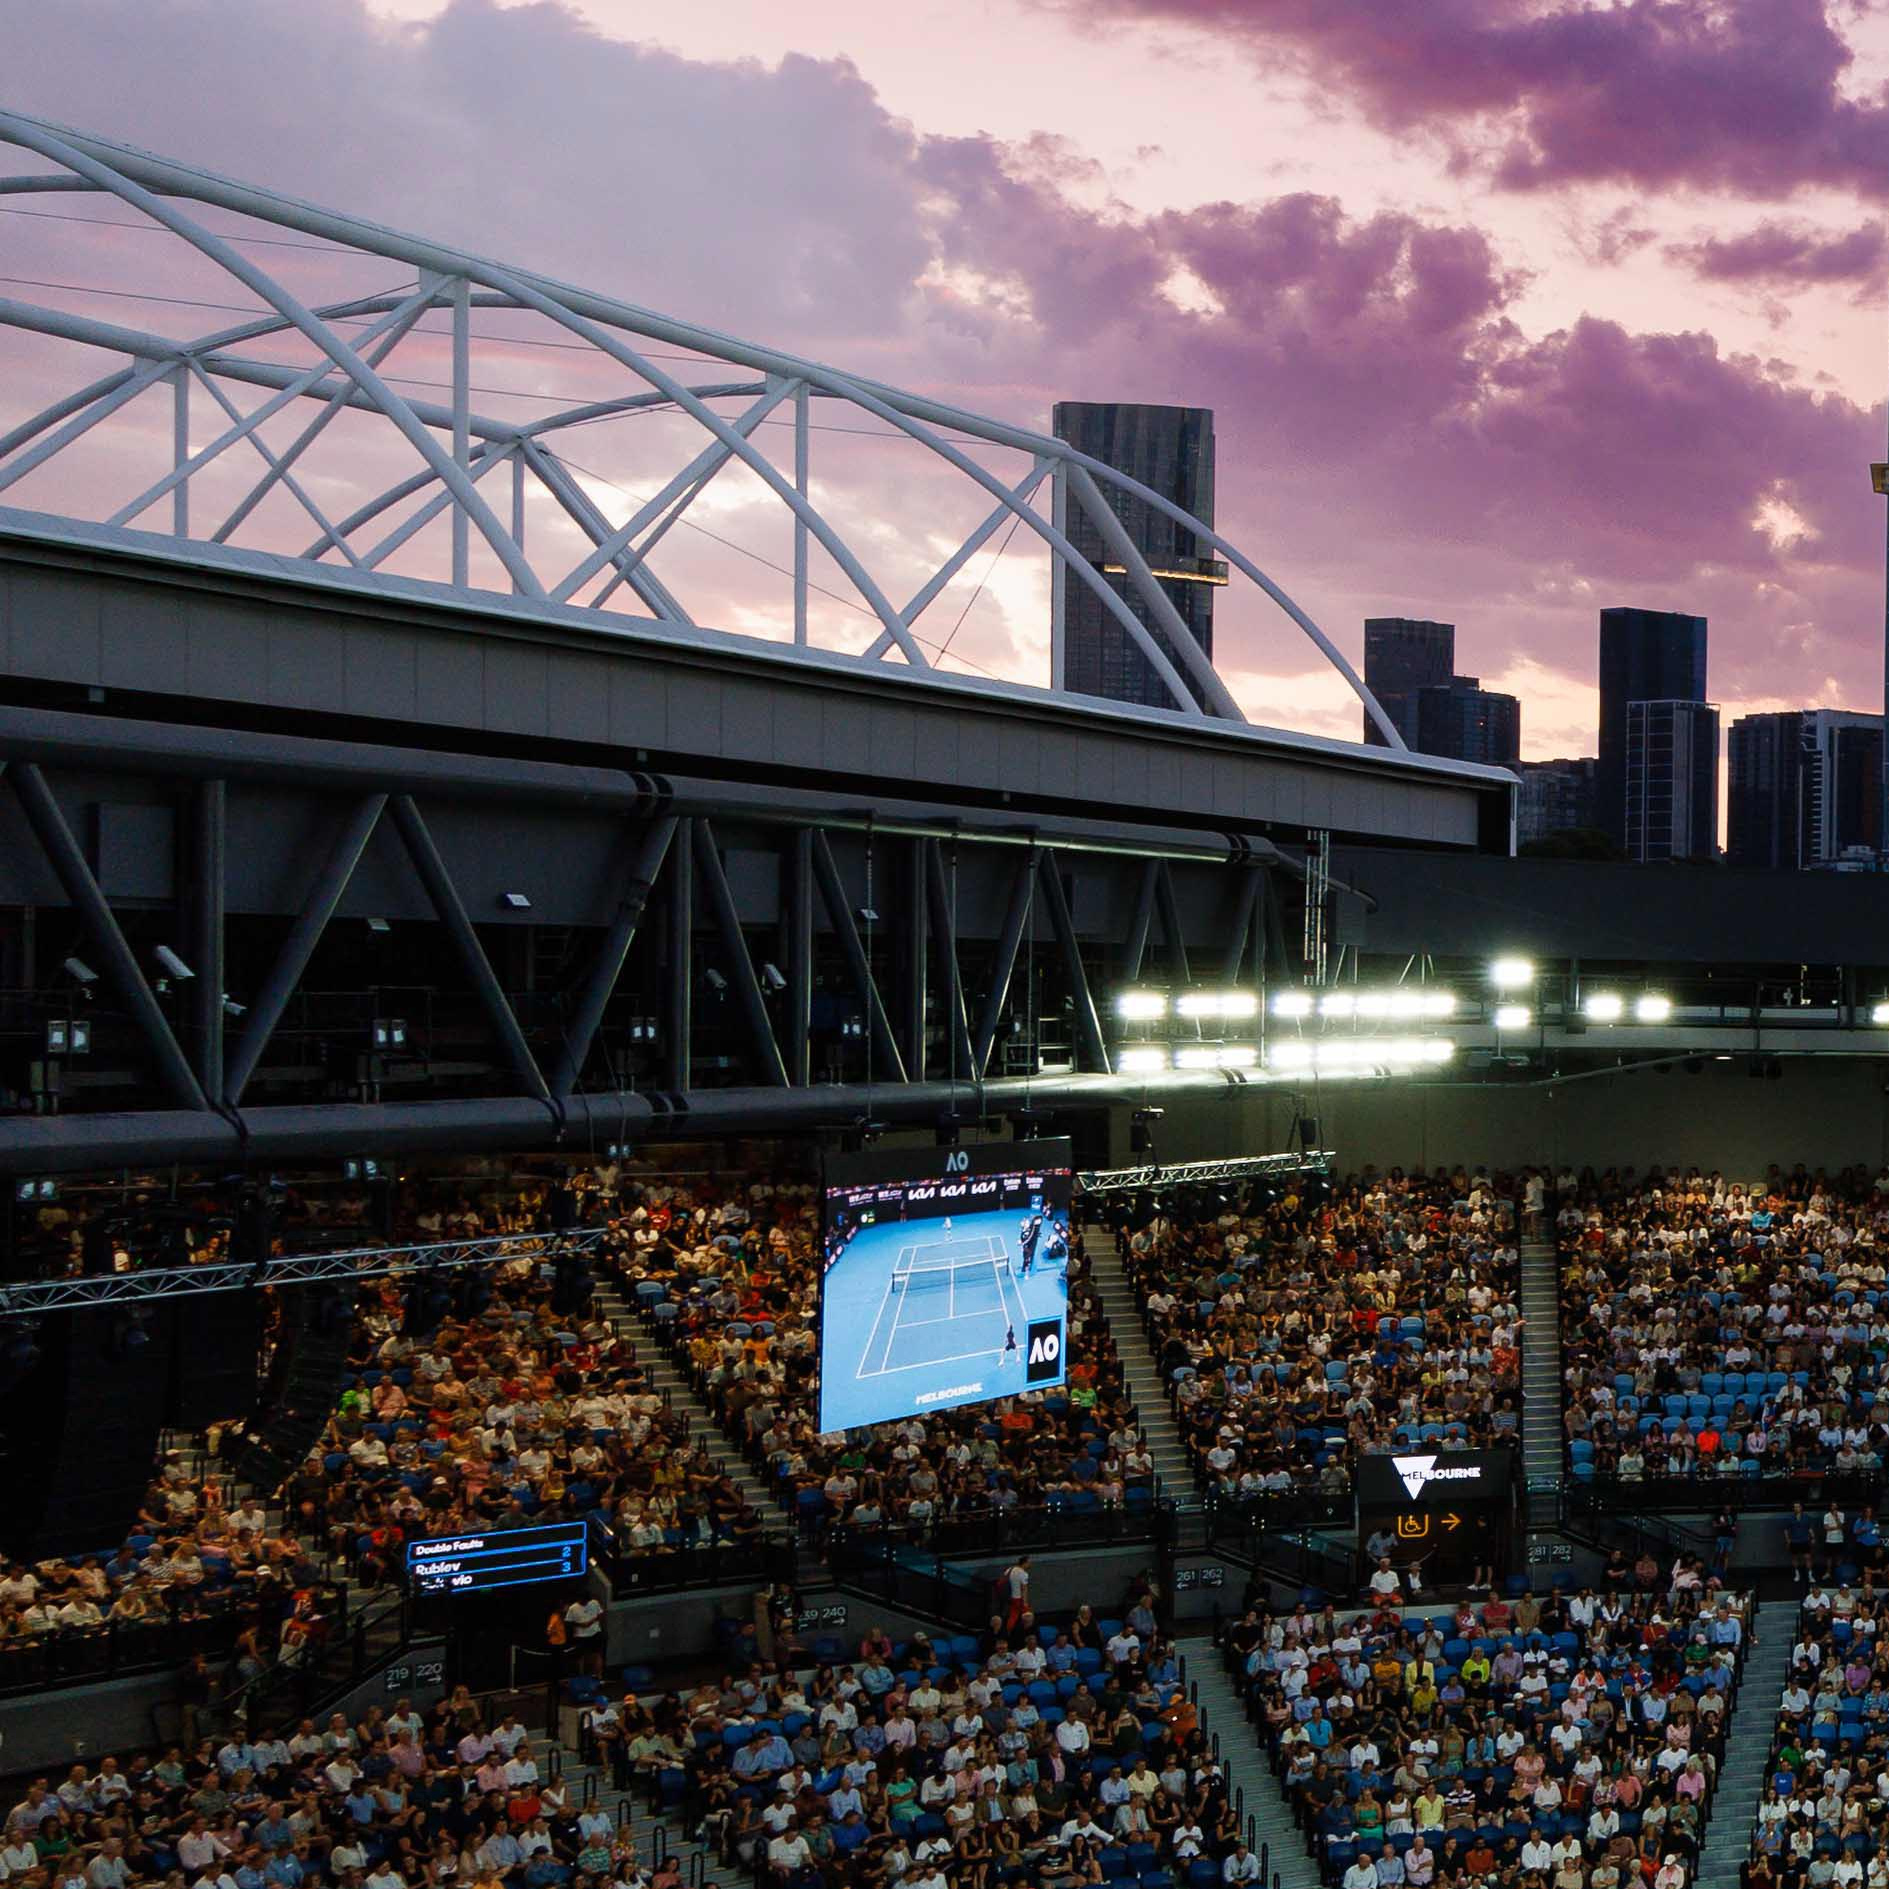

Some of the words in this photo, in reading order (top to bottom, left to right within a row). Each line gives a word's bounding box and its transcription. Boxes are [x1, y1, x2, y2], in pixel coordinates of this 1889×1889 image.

[1029, 1334, 1059, 1365] AO
[1403, 1467, 1481, 1482] MELBOURNE
[415, 1562, 461, 1575] Rublev
[561, 1547, 571, 1557] 2
[561, 1561, 571, 1573] 3
[1177, 1571, 1196, 1582] 261
[1202, 1568, 1223, 1580] 262
[386, 1666, 409, 1681] 219
[416, 1663, 443, 1678] 220
